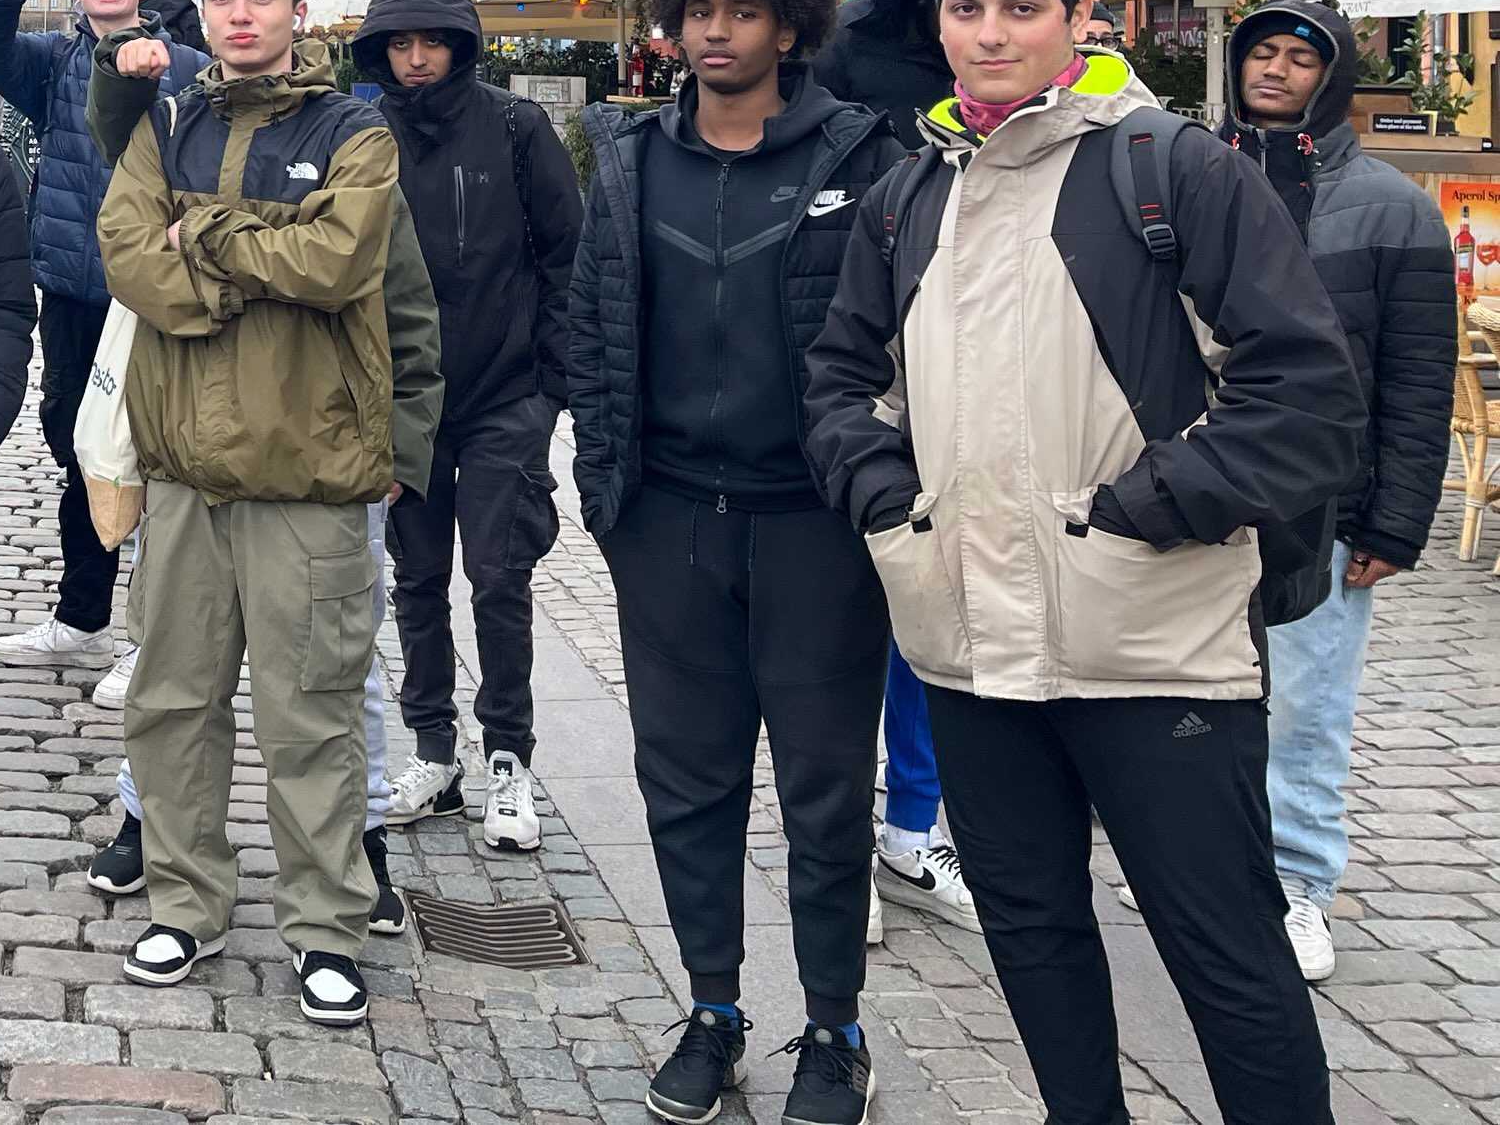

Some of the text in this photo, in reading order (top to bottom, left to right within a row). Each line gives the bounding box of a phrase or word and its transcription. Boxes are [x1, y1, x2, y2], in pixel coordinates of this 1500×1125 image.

[814, 189, 847, 205] NIKE
[1452, 189, 1500, 204] Aperol Sp
[1172, 723, 1213, 738] adidas
